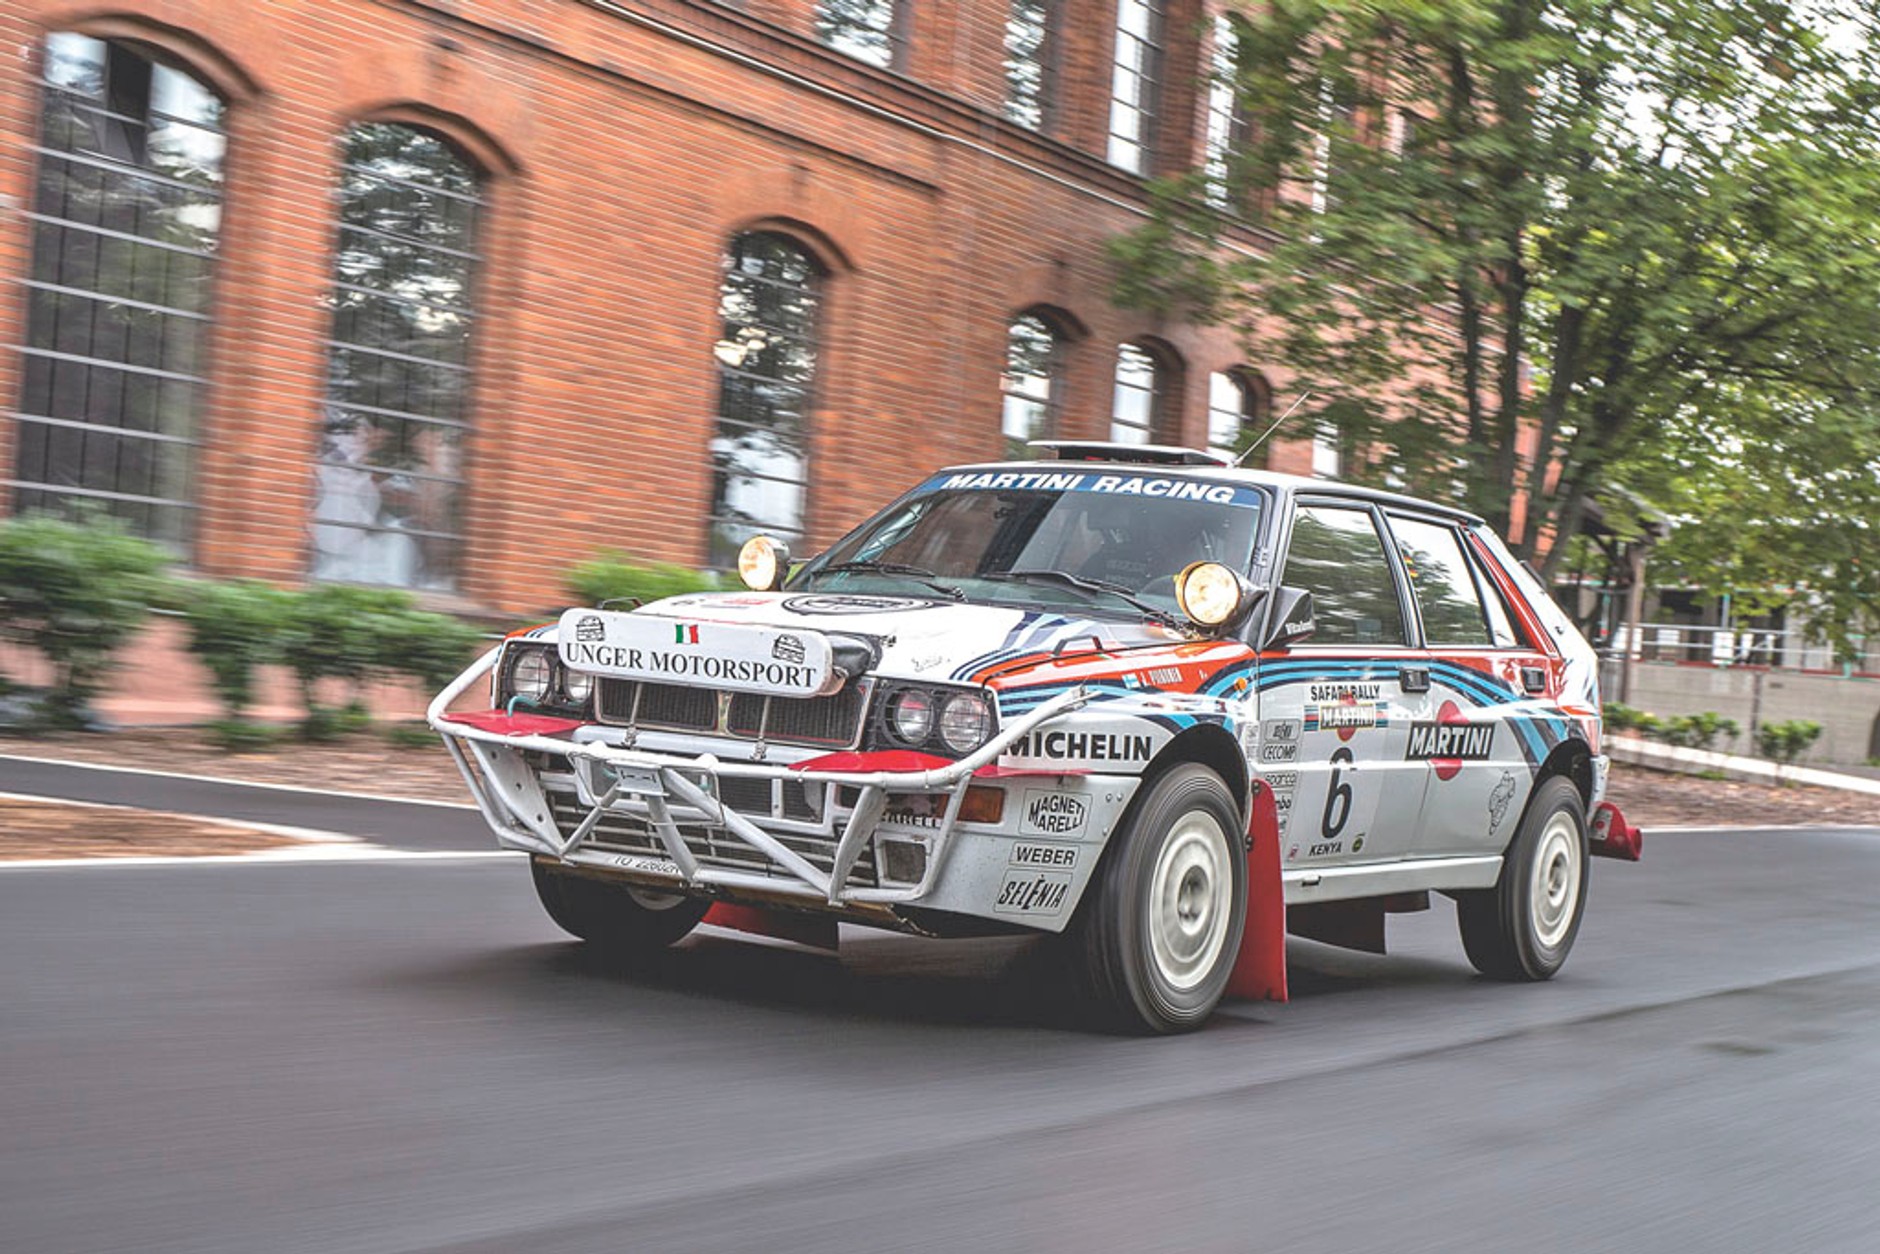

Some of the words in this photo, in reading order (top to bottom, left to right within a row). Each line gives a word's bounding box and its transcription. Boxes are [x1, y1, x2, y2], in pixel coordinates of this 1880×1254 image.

[940, 473, 1084, 490] MARTINI
[1091, 475, 1235, 503] RACING
[566, 642, 643, 670] UNGER
[649, 651, 817, 688] MOTORSPORT
[1310, 685, 1349, 701] SAFARI
[1350, 684, 1380, 699] RALLY
[1321, 706, 1374, 729] MARTINI
[1000, 730, 1153, 762] MICHELIN
[1408, 726, 1493, 758] MARTINI
[1321, 747, 1354, 839] 6
[1028, 795, 1086, 818] MAGNETI
[1027, 812, 1084, 833] MARELLI
[1016, 846, 1076, 866] WEBER
[1308, 842, 1343, 857] KENYA
